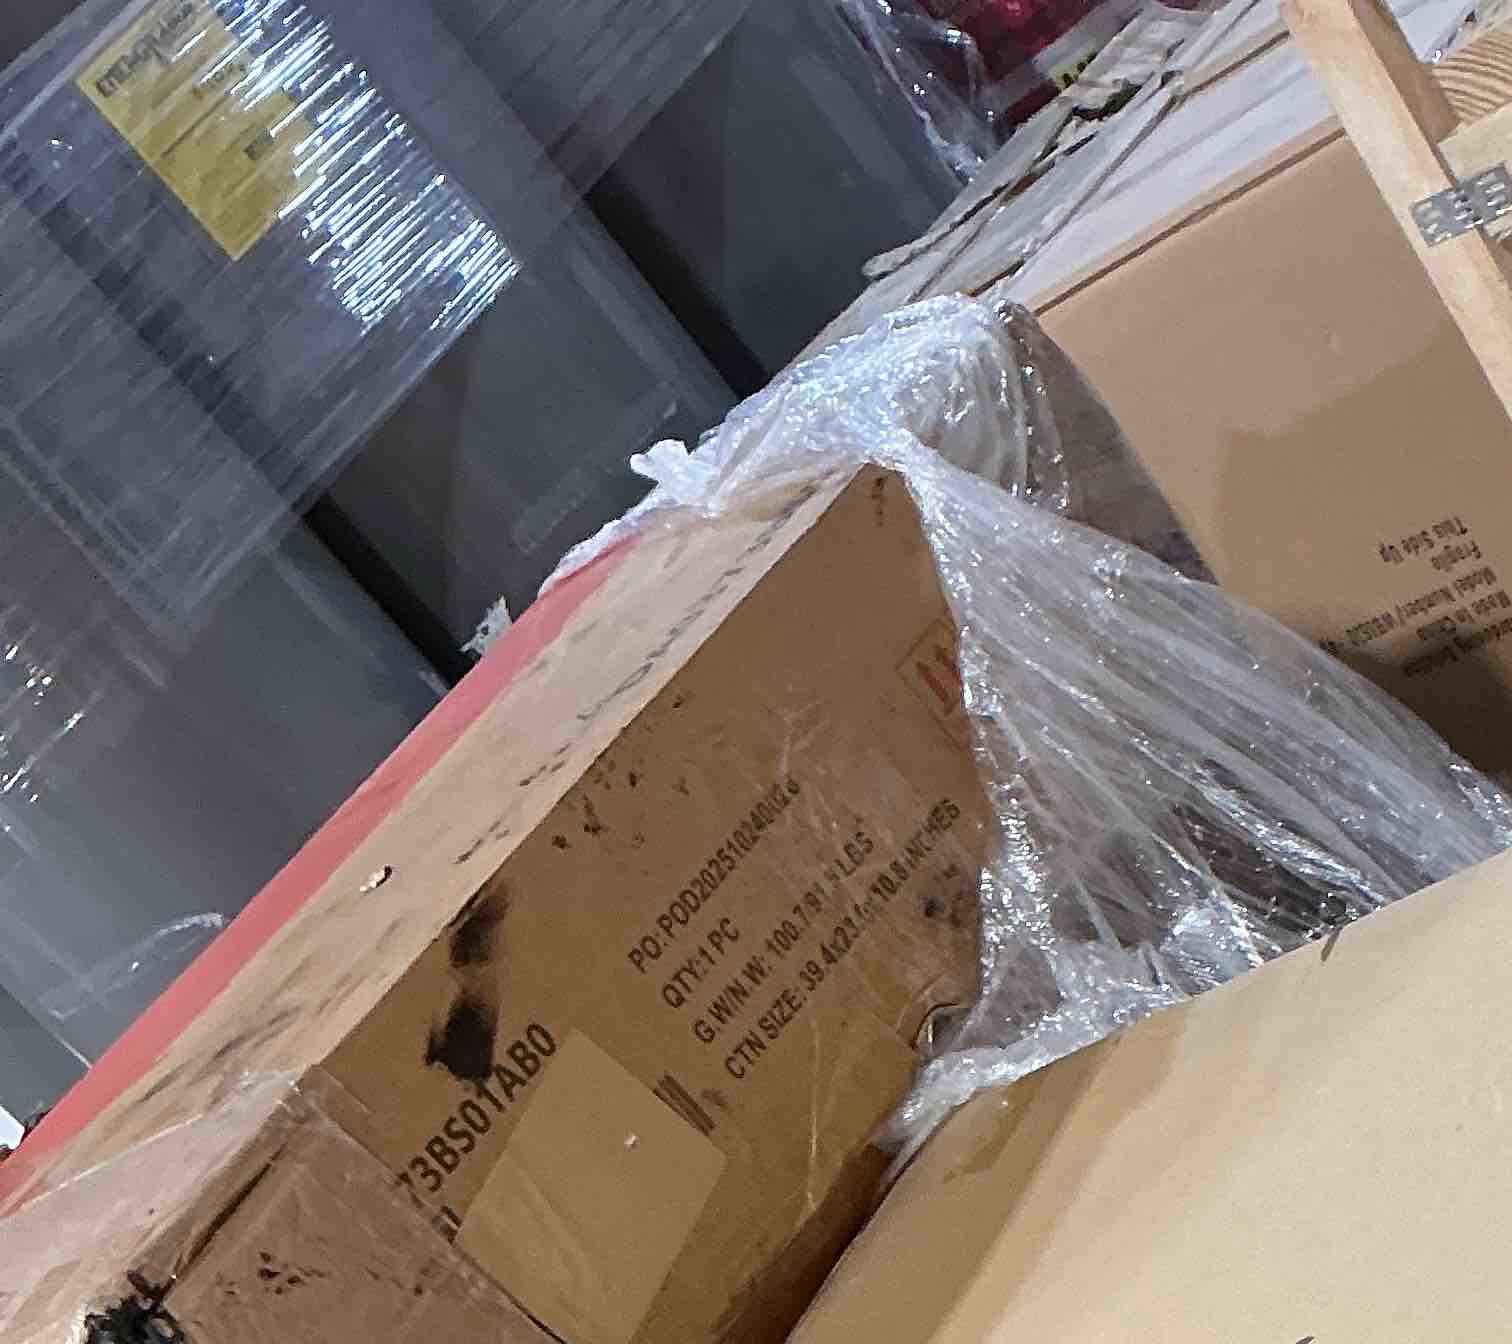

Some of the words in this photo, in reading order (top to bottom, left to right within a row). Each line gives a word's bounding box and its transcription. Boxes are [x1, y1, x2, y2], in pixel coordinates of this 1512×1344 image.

[1401, 530, 1435, 556] Side
[1432, 516, 1468, 539] This
[1379, 542, 1404, 565] Up
[1431, 541, 1482, 572] Fragile
[834, 831, 874, 878] LBS
[706, 916, 740, 956] PC
[724, 1029, 768, 1079] CTN
[758, 988, 807, 1040] SIZE:
[904, 797, 960, 870] INCHES
